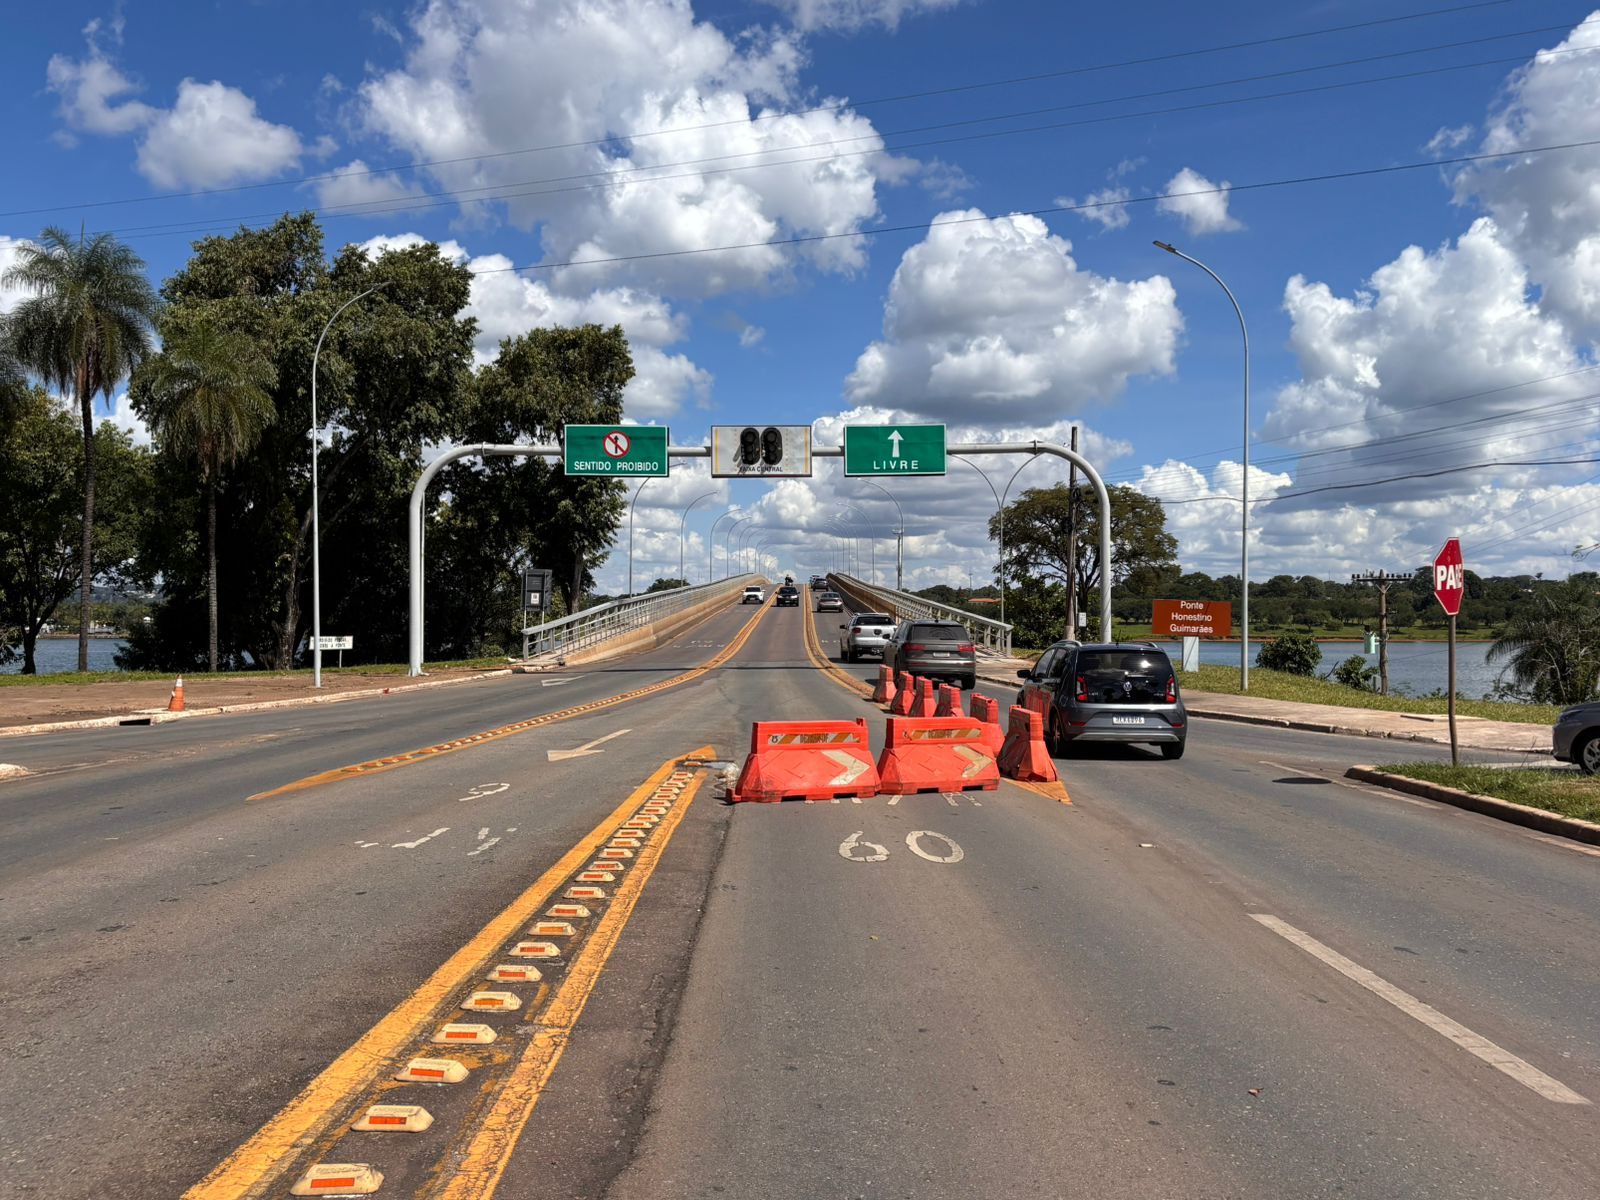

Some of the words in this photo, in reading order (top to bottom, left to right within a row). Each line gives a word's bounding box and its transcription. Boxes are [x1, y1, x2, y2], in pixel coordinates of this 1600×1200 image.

[574, 461, 611, 471] SENTIDO
[616, 461, 659, 471] PROIBIDO
[873, 460, 919, 470] LIVRE
[1180, 601, 1204, 610] Ponte
[1171, 612, 1213, 622] Honestino
[1169, 623, 1214, 634] Guimarães
